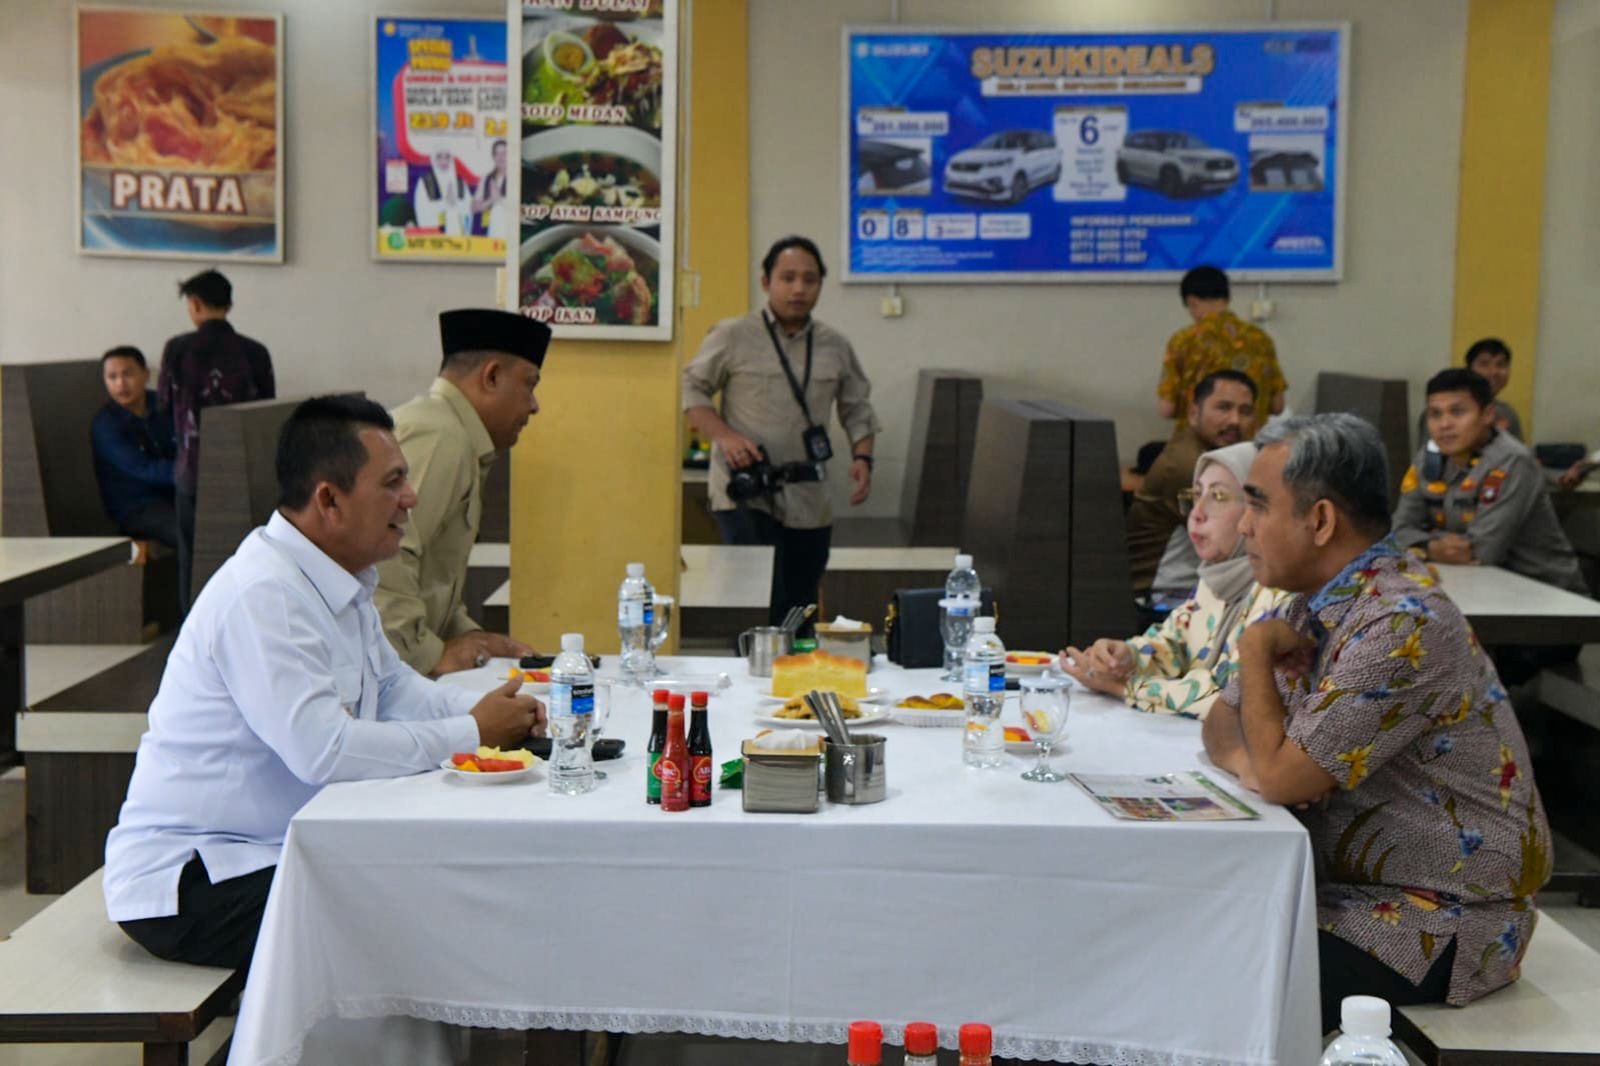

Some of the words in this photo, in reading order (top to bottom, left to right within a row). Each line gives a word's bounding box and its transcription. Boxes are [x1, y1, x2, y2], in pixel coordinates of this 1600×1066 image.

[971, 45, 1214, 78] SUZUKIDEALS
[520, 103, 564, 119] SOTO
[567, 104, 627, 122] MEDAN
[1079, 115, 1100, 145] 6
[112, 169, 247, 214] PRATA
[550, 205, 592, 221] AYAM
[861, 218, 877, 237] 0
[895, 218, 910, 237] 8
[522, 305, 553, 322] OP
[554, 306, 597, 323] IKAN
